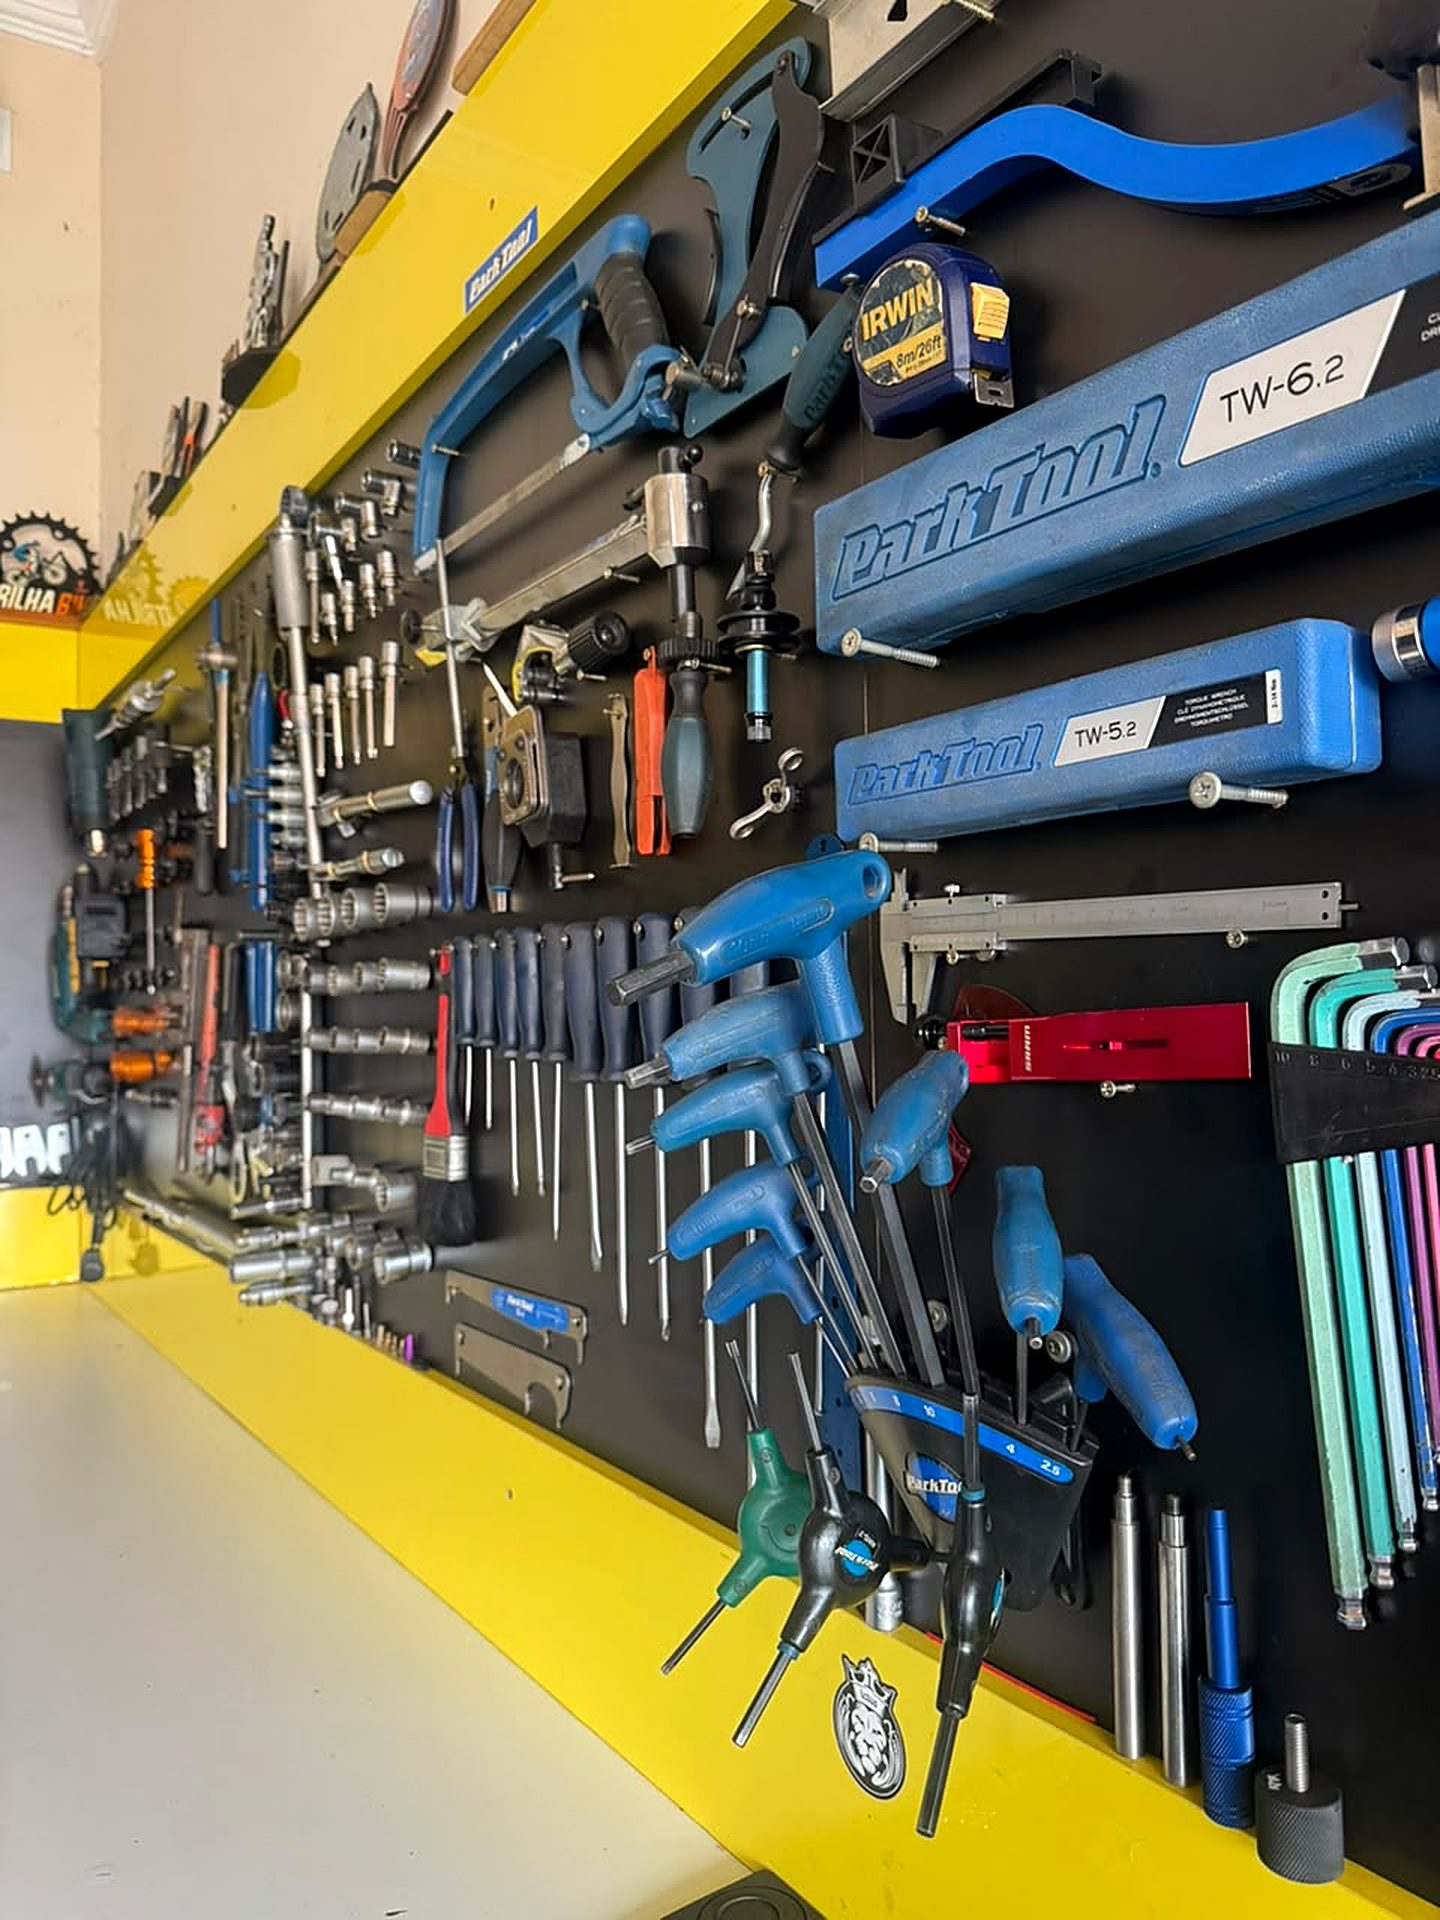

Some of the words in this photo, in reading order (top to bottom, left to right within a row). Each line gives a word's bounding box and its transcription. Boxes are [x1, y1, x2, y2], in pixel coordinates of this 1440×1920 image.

[860, 274, 934, 341] IRWIN
[1219, 354, 1345, 422] TW-6.2
[1074, 721, 1137, 748] TW-5.2
[1275, 1051, 1290, 1065] 10
[1006, 1443, 1016, 1455] 4
